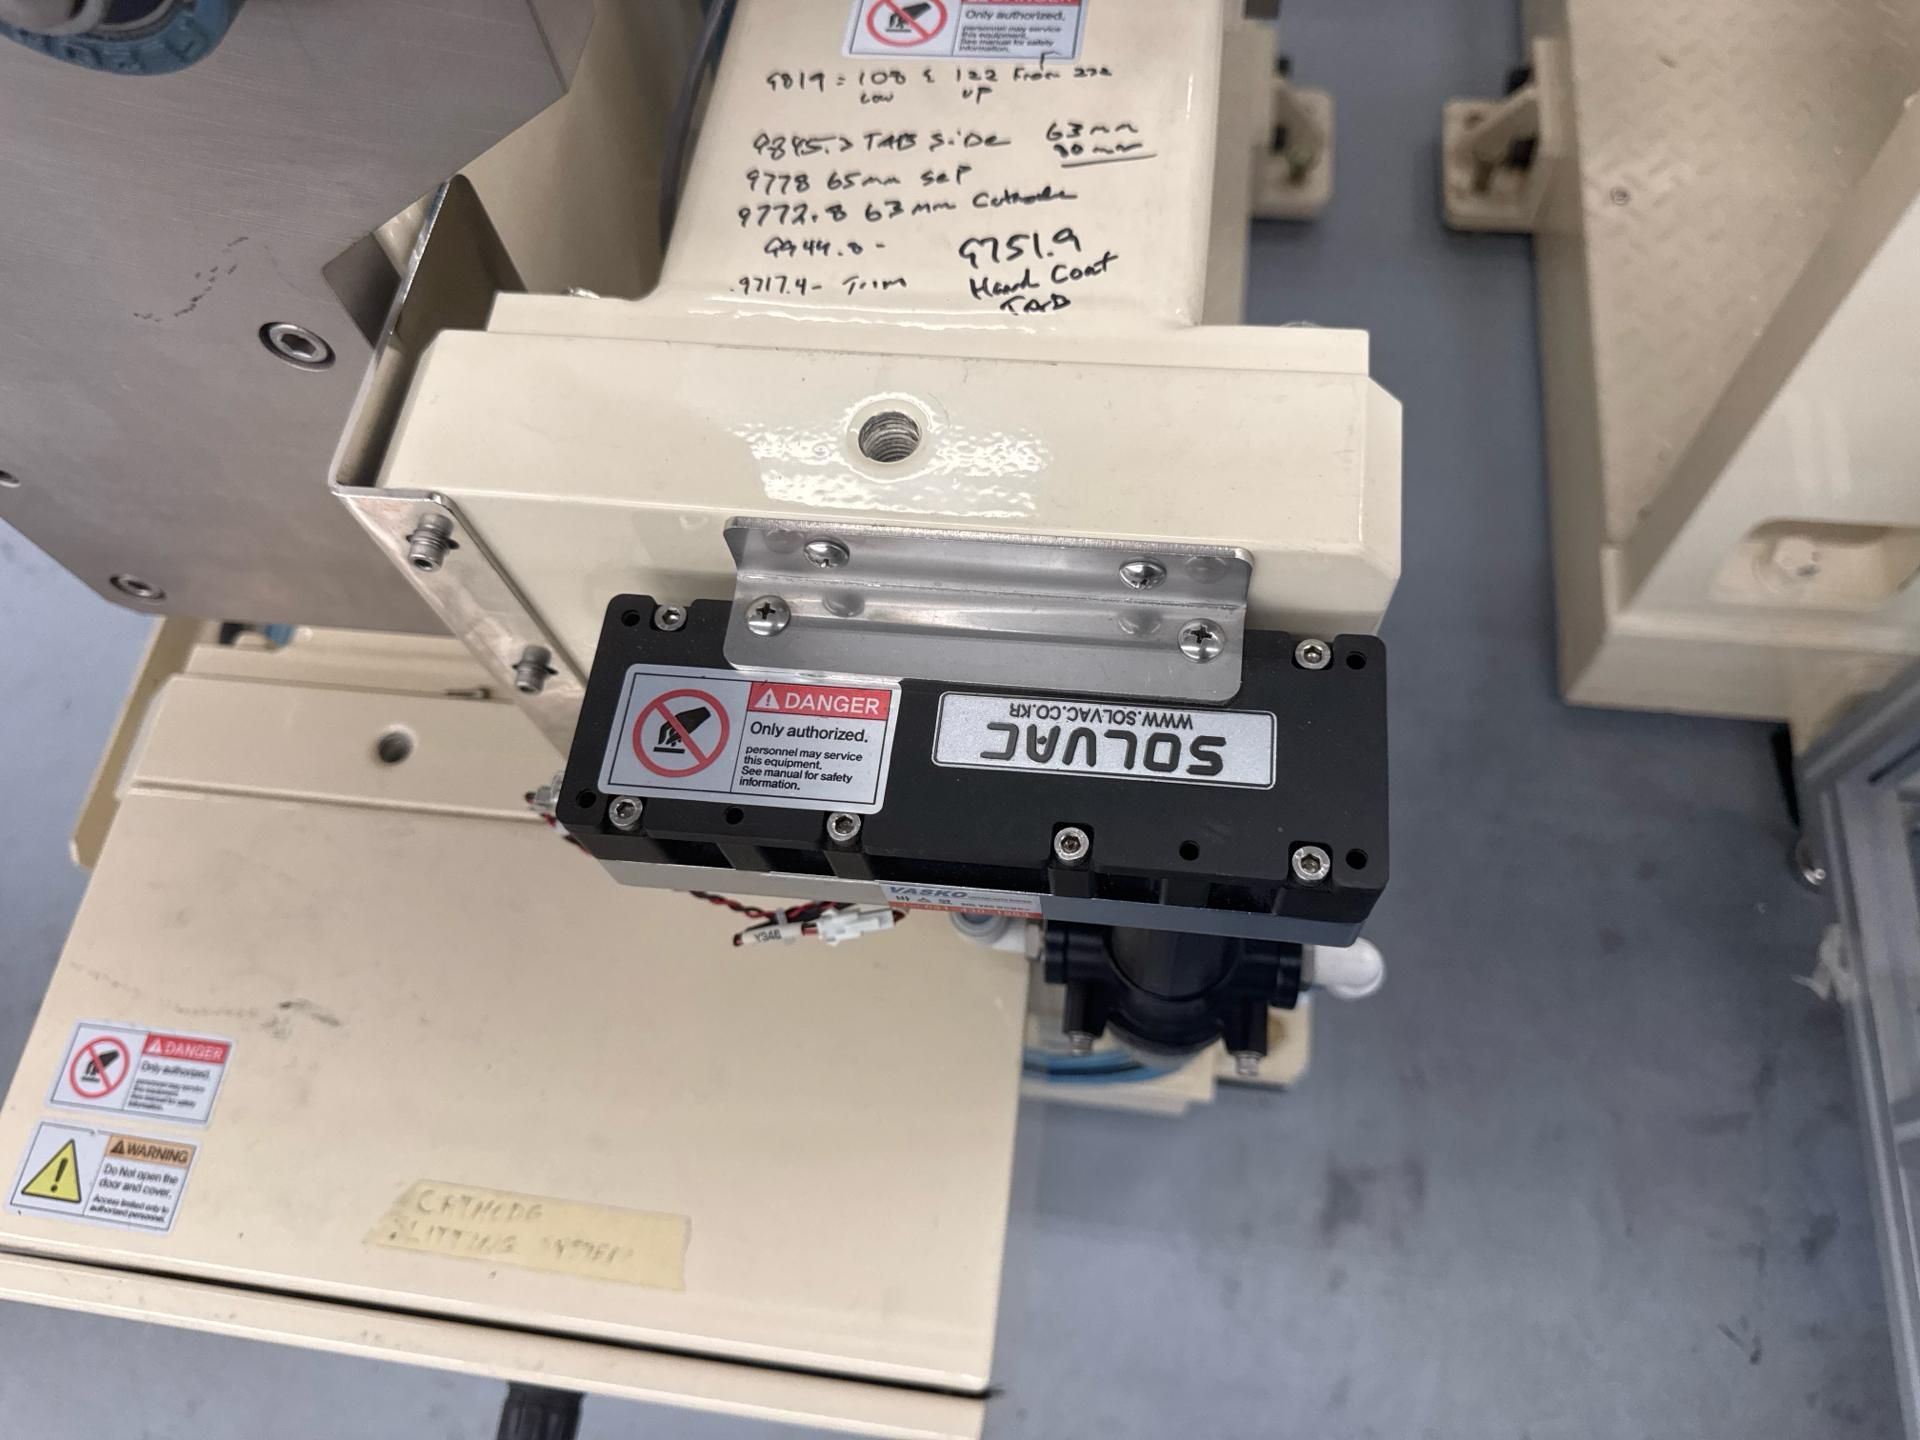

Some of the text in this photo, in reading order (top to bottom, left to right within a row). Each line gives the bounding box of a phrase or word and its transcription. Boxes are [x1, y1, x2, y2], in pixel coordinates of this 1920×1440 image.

[965, 10, 993, 20] Only
[784, 692, 880, 715] DANGER
[1009, 701, 1194, 730] WWW.SOLVAC.CO.KR
[750, 721, 869, 743] Only authorized.
[745, 745, 863, 762] personnel may service
[980, 721, 1227, 776] SOLVAC
[743, 755, 823, 771] this equipment.
[739, 776, 800, 791] information.
[741, 766, 853, 784] See manual for safety
[890, 886, 967, 898] VASKO
[165, 1041, 223, 1060] DANGER
[127, 1143, 188, 1163] WARNING
[103, 1163, 118, 1174] Do
[163, 1173, 179, 1184] the
[99, 1178, 121, 1189] door
[122, 1182, 142, 1193] and
